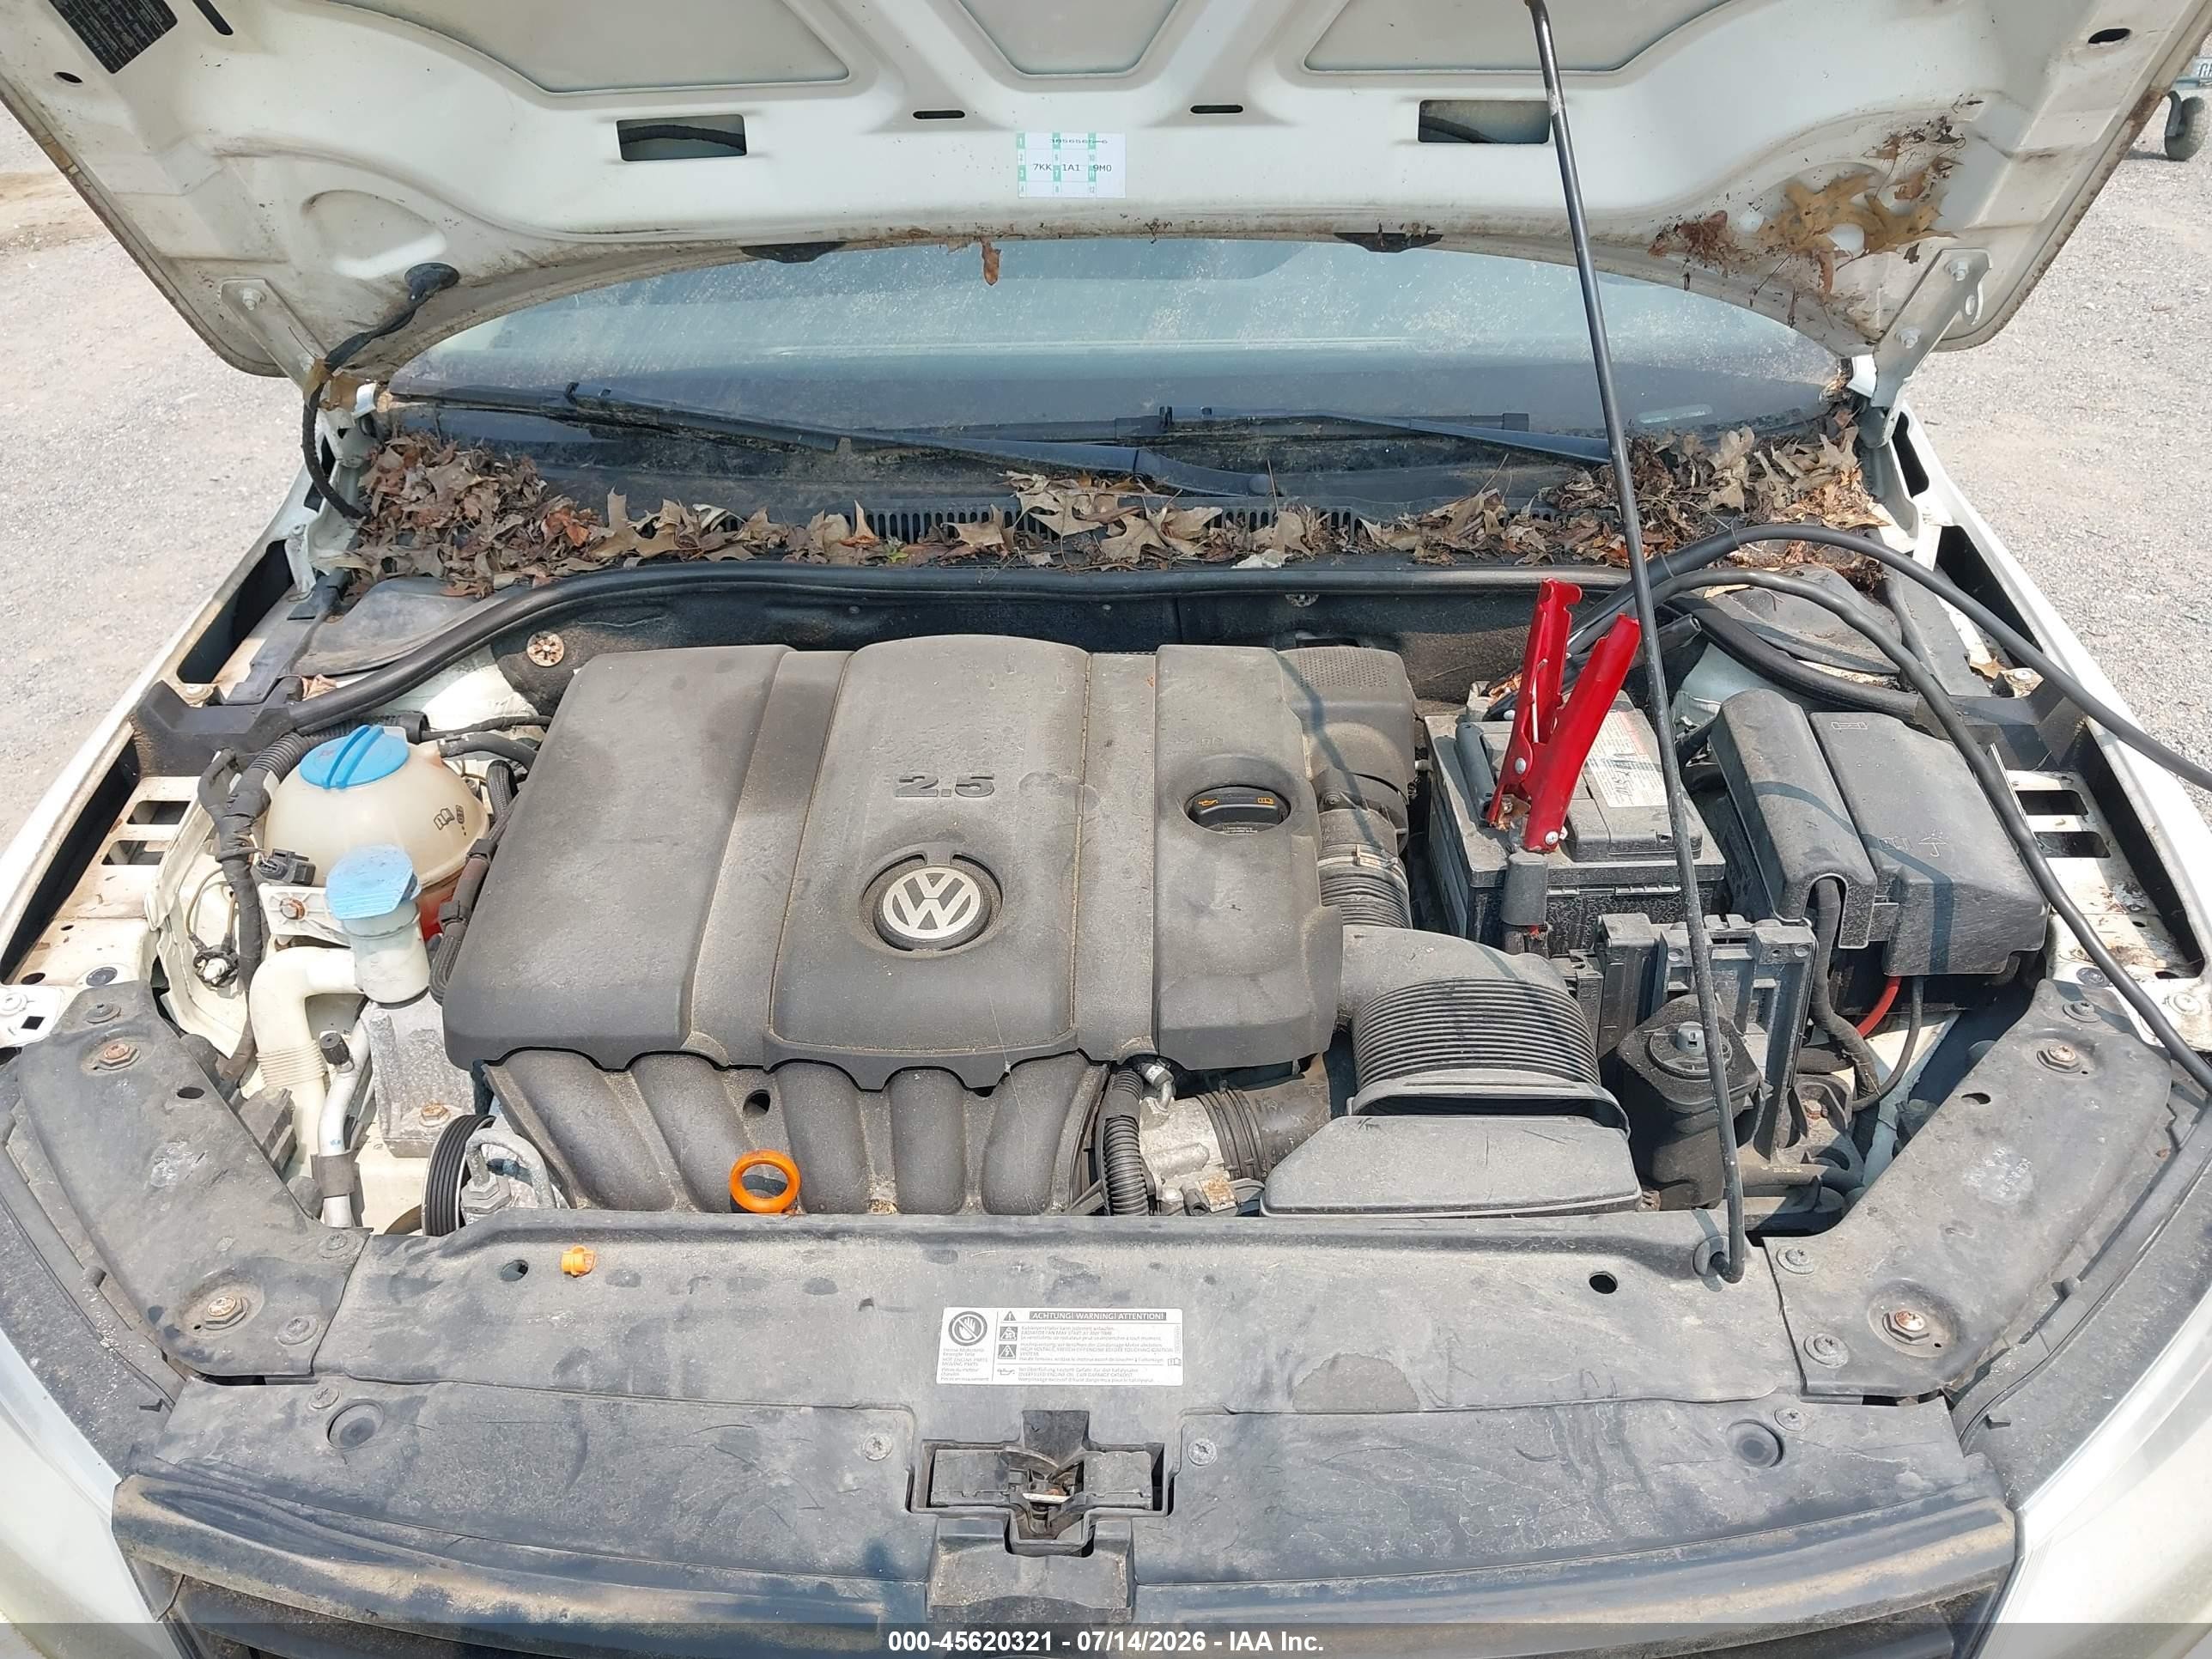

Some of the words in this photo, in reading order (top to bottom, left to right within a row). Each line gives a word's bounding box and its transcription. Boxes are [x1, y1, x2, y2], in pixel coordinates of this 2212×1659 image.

[1033, 163, 1052, 172] 7KK
[895, 775, 995, 799] 2.5
[883, 866, 981, 939] VW
